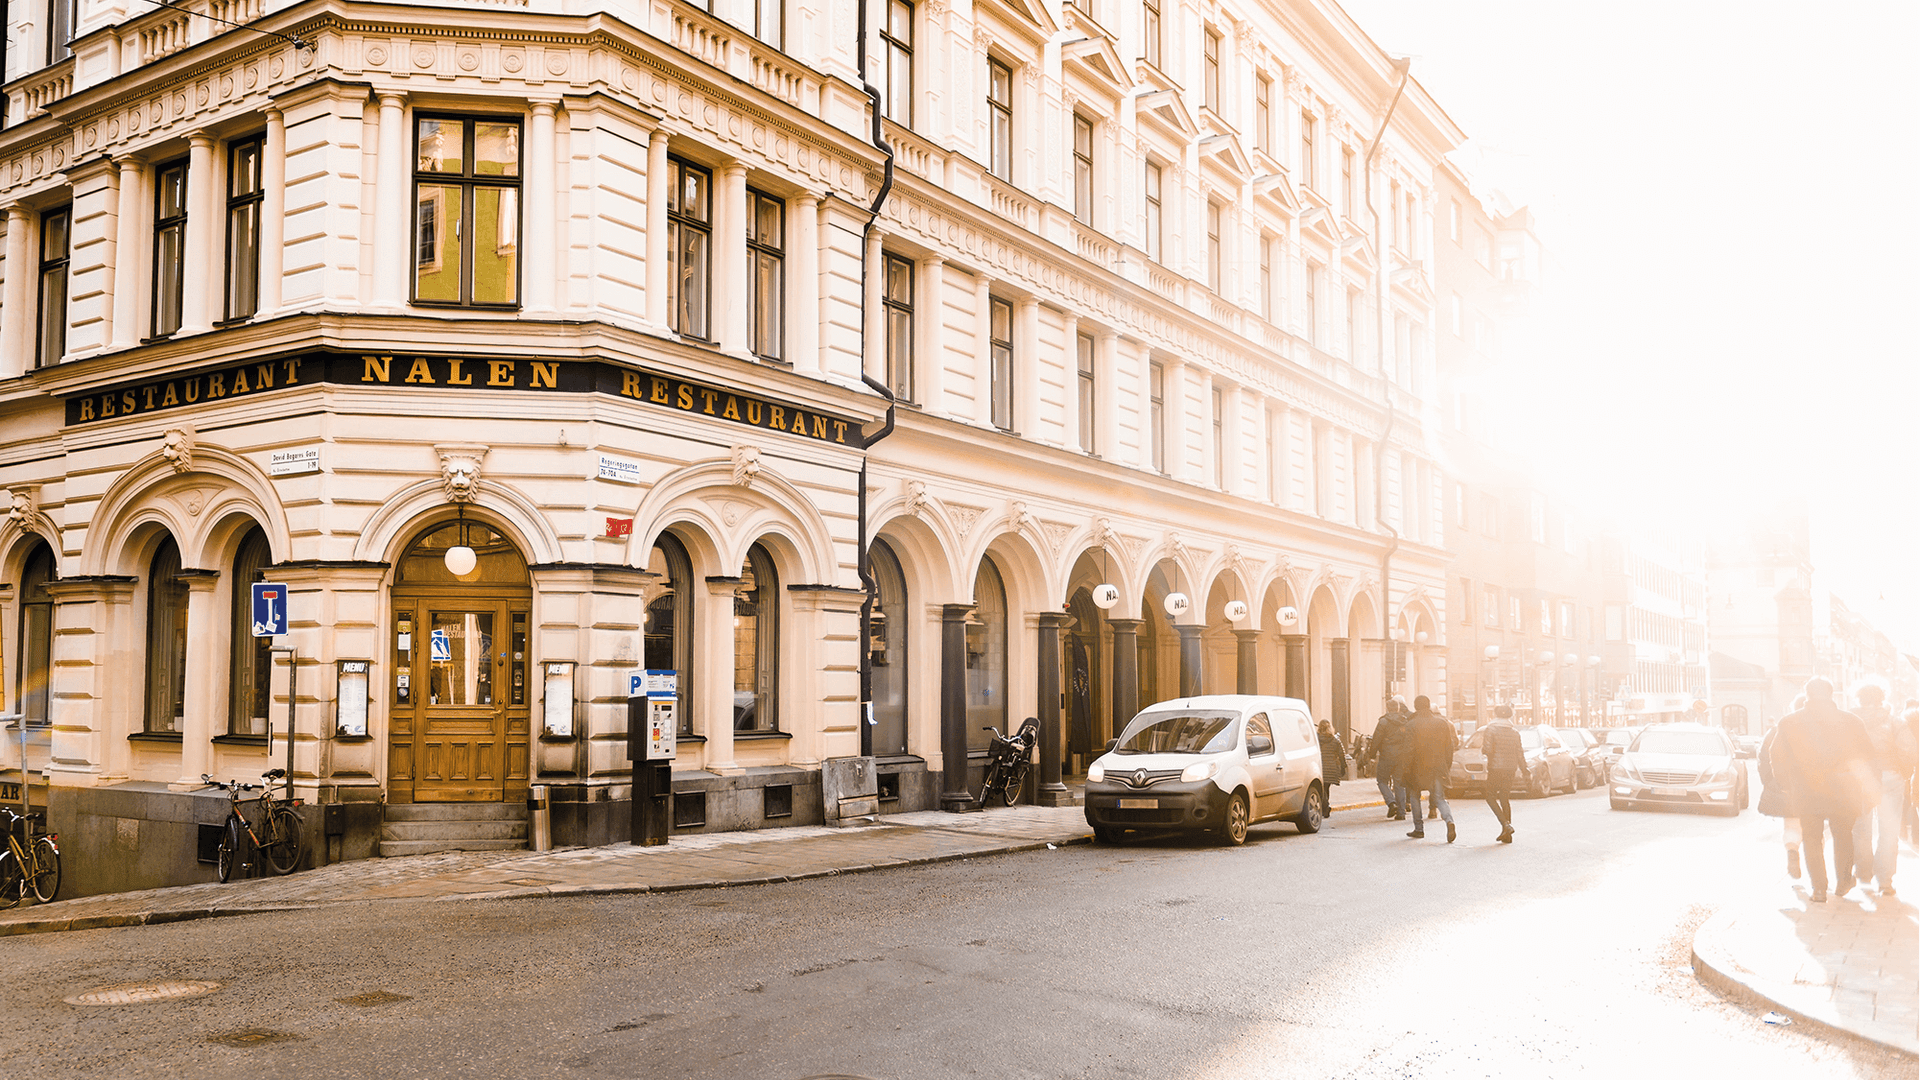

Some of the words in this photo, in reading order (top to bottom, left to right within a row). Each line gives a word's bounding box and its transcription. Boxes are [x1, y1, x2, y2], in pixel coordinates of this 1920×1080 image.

[361, 356, 560, 388] NALEN
[79, 357, 301, 422] RESTAURANT
[620, 368, 848, 444] RESTAURANT
[343, 662, 365, 673] MENU
[548, 664, 570, 675] MENU
[631, 675, 642, 694] P
